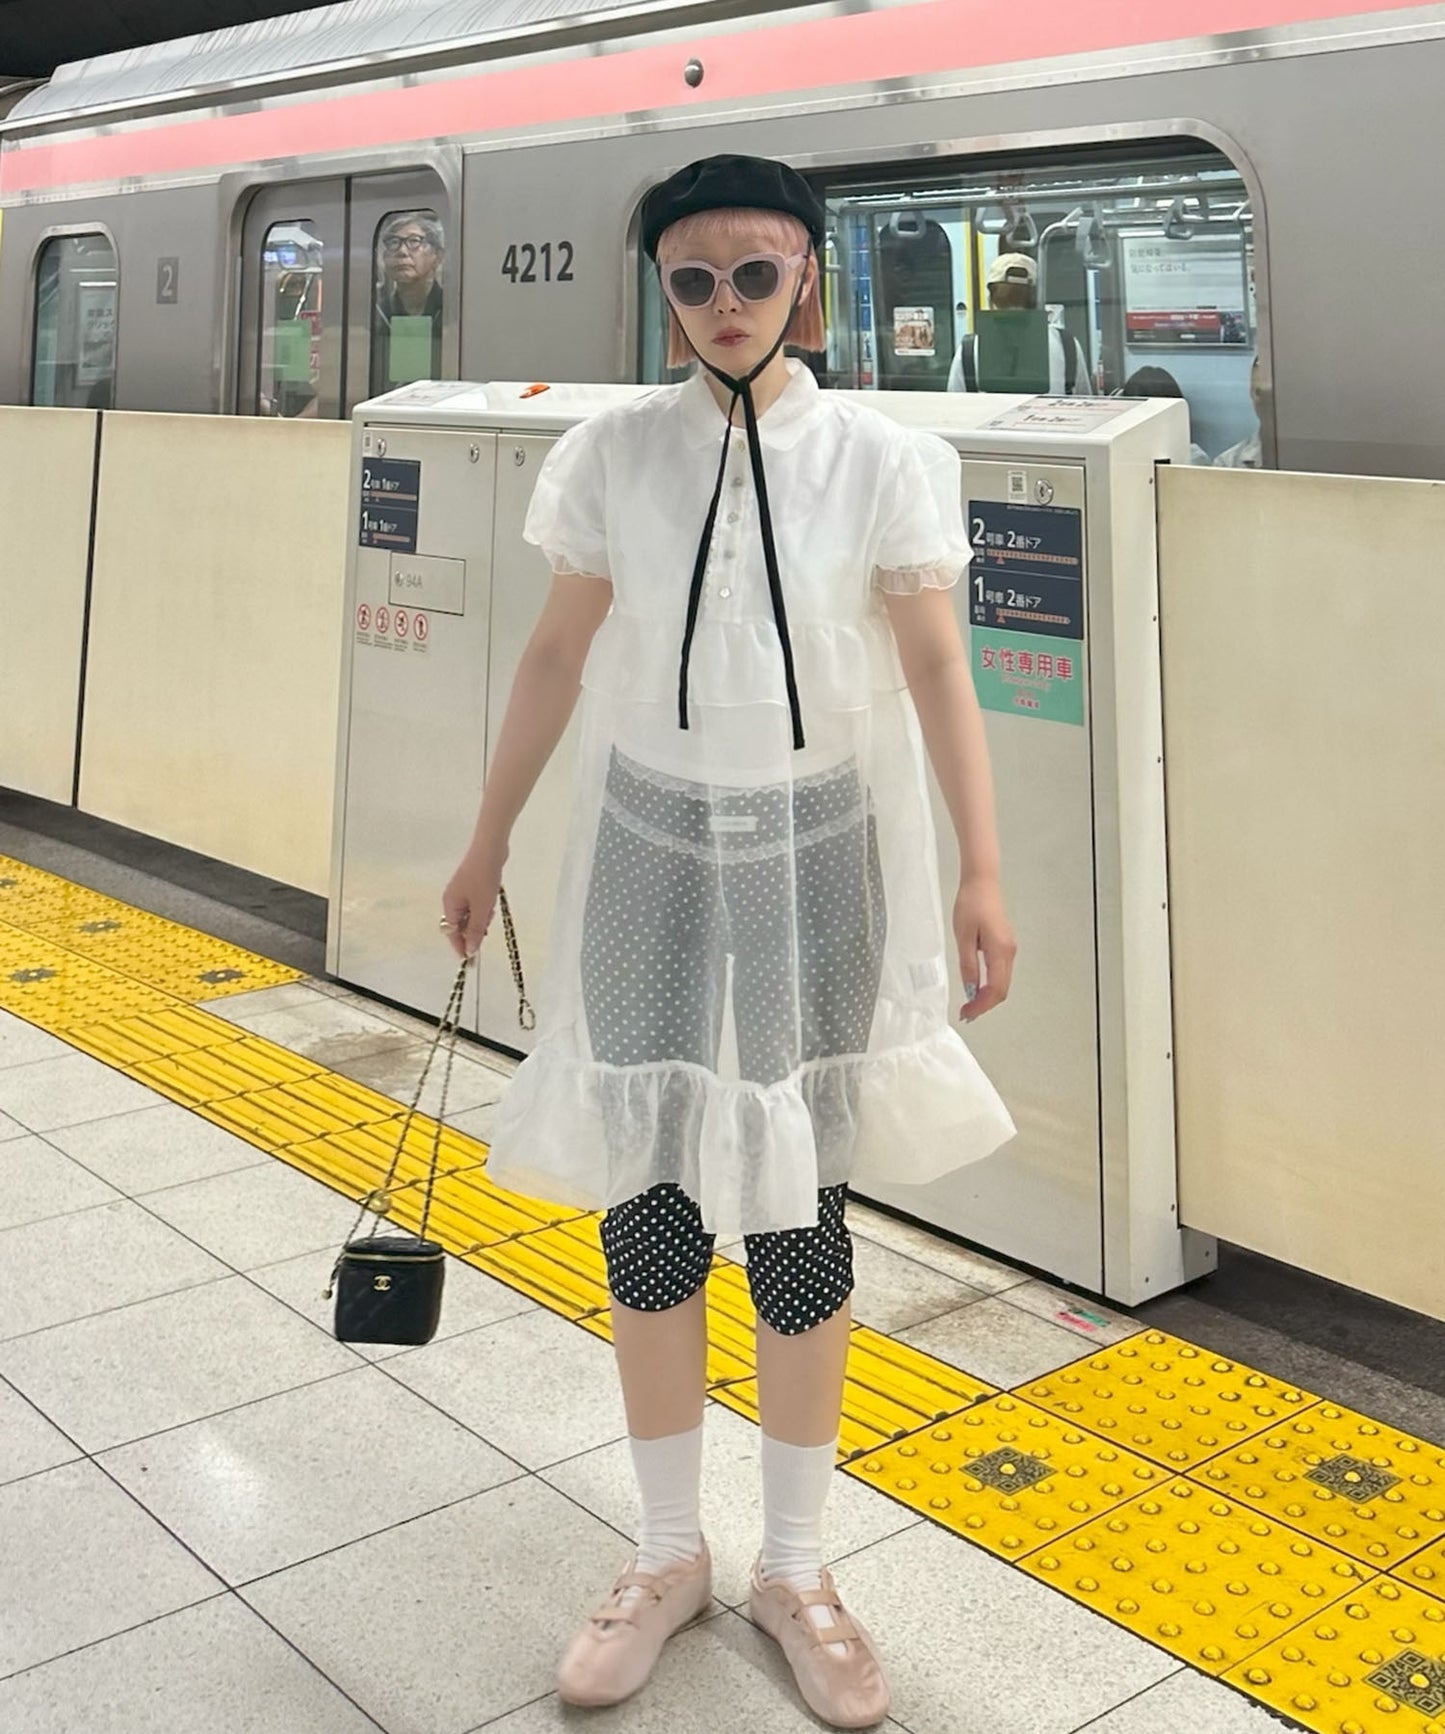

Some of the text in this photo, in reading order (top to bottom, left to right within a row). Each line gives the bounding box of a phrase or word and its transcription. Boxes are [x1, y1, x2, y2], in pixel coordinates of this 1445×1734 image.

[502, 241, 574, 283] 4212
[161, 264, 173, 297] 2
[1007, 589, 1042, 608] 2番ドア
[980, 645, 1073, 681] 女性専用車
